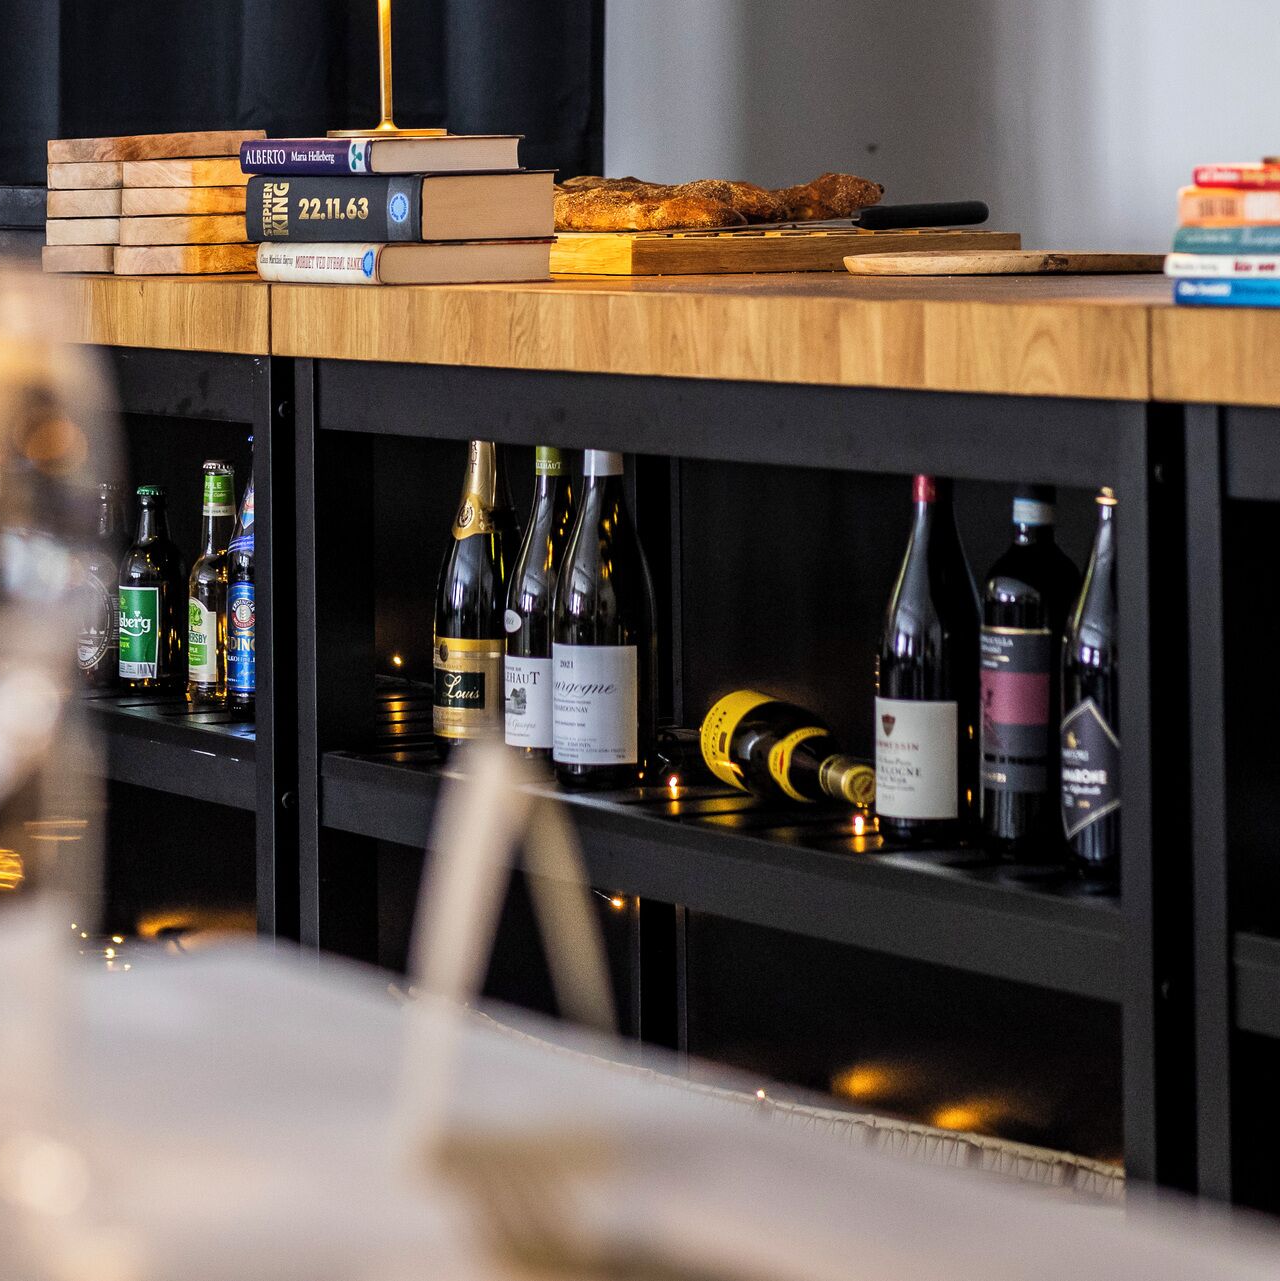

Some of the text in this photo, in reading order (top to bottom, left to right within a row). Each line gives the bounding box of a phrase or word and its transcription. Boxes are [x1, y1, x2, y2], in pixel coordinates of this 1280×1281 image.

[245, 149, 335, 165] ALBERTO Maria Helleberg
[263, 182, 274, 237] STEPHEN
[272, 182, 290, 236] KING
[298, 197, 369, 220] 22.11.63
[559, 660, 574, 669] 2021
[443, 673, 480, 699] Louis
